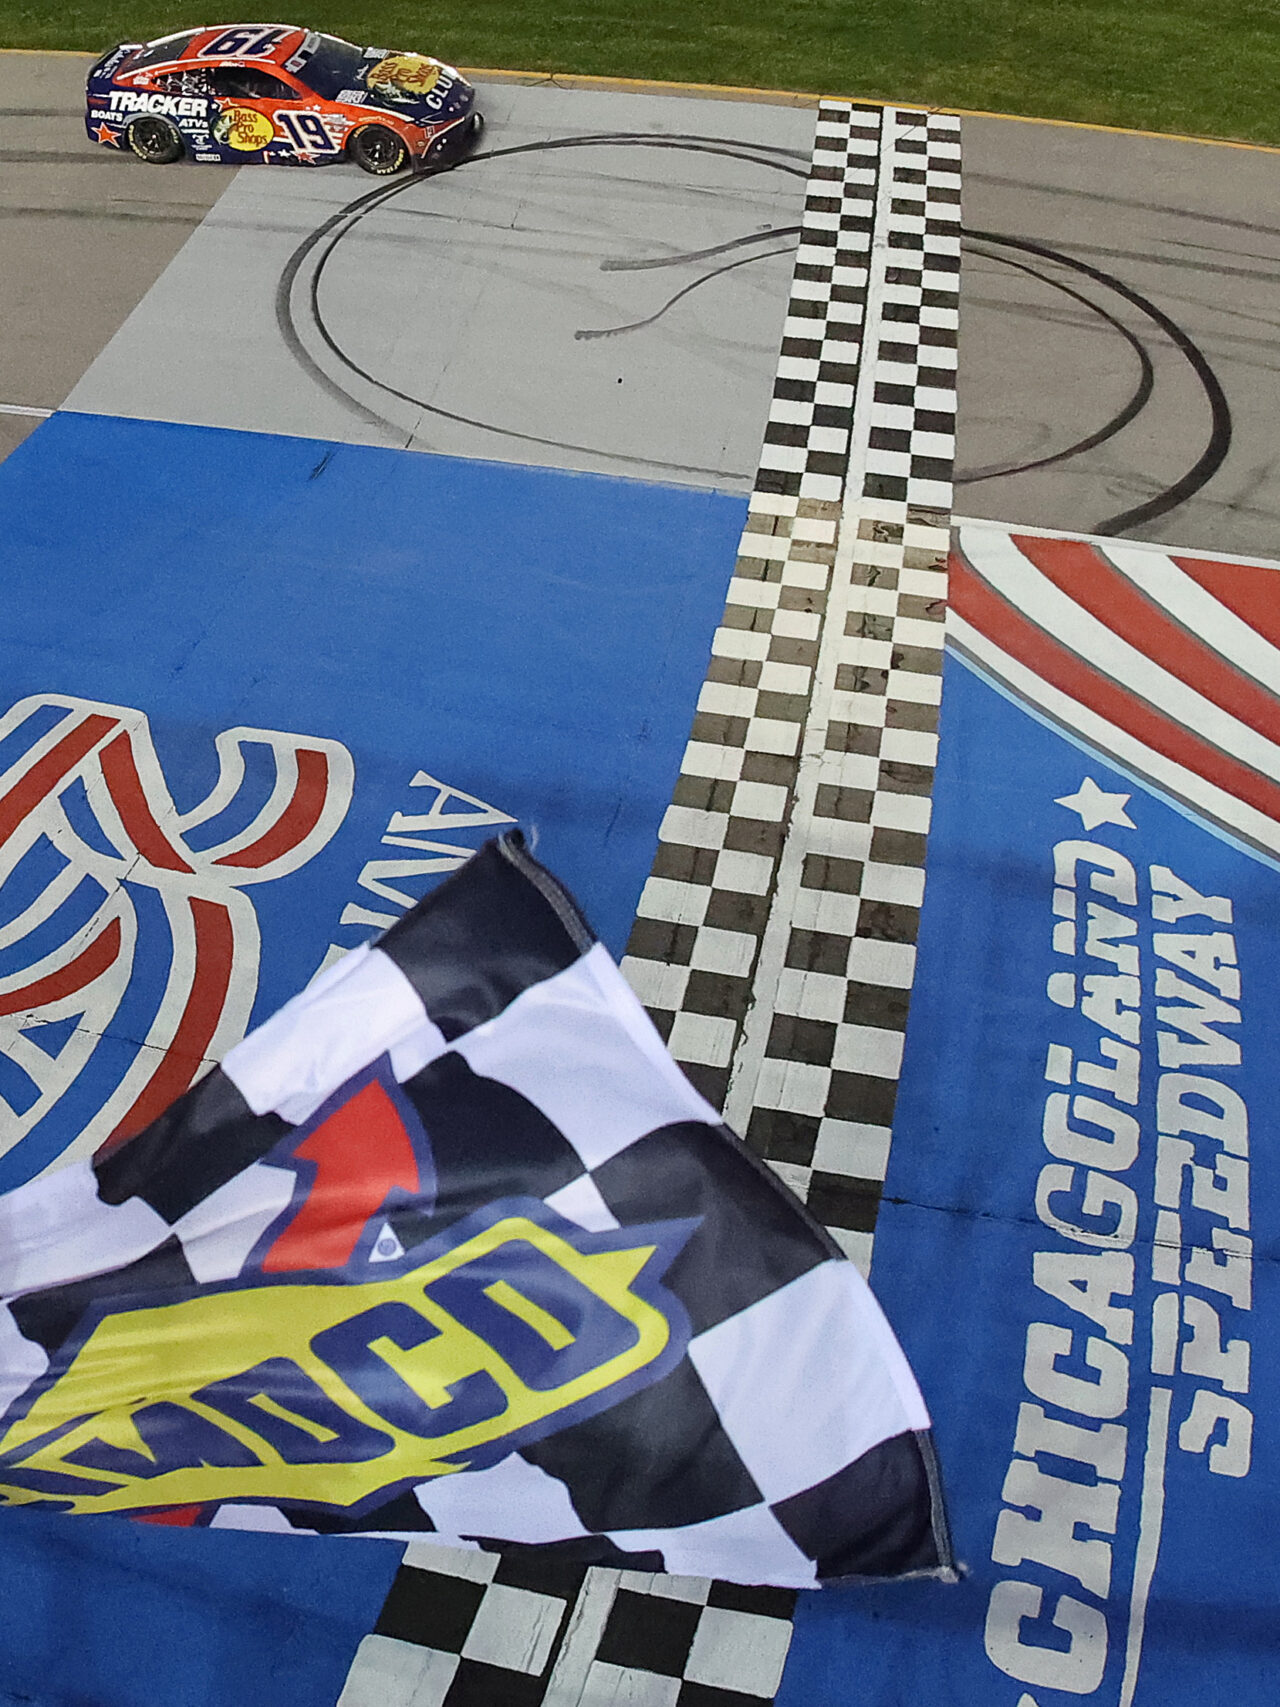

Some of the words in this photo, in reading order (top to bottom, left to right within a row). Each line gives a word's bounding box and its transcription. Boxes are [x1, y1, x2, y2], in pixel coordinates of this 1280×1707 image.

[109, 91, 208, 117] TRACKER
[91, 109, 123, 121] BOATS
[233, 110, 258, 123] Bass
[178, 118, 209, 128] ATVs
[235, 120, 254, 133] Pro
[238, 132, 267, 146] Shops
[275, 111, 338, 153] 19
[1149, 863, 1254, 1478] SPEEDWAY
[983, 839, 1144, 1695] CHICAGOLAND
